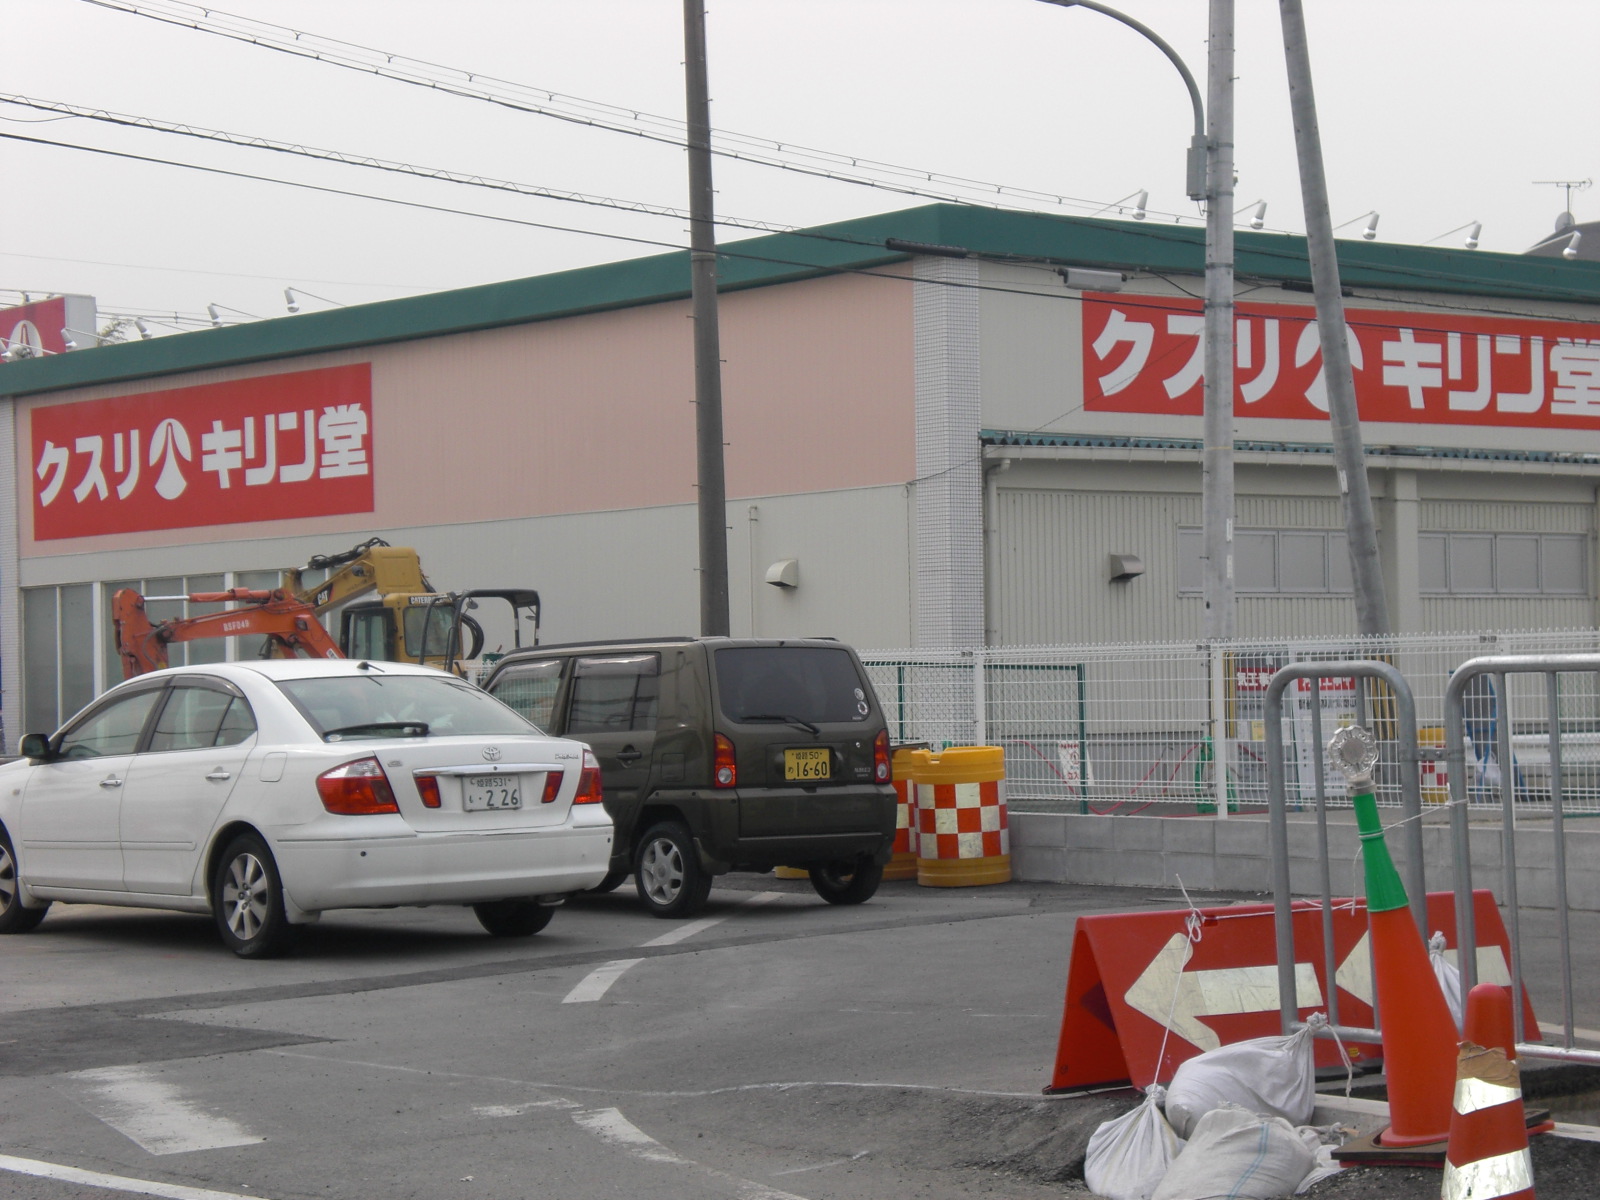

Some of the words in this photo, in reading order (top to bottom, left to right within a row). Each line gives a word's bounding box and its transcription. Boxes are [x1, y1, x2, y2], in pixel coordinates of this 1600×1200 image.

[36, 429, 140, 508] クスリ
[201, 402, 369, 489] キリン堂
[317, 590, 329, 605] CAT
[796, 761, 828, 777] 16-60
